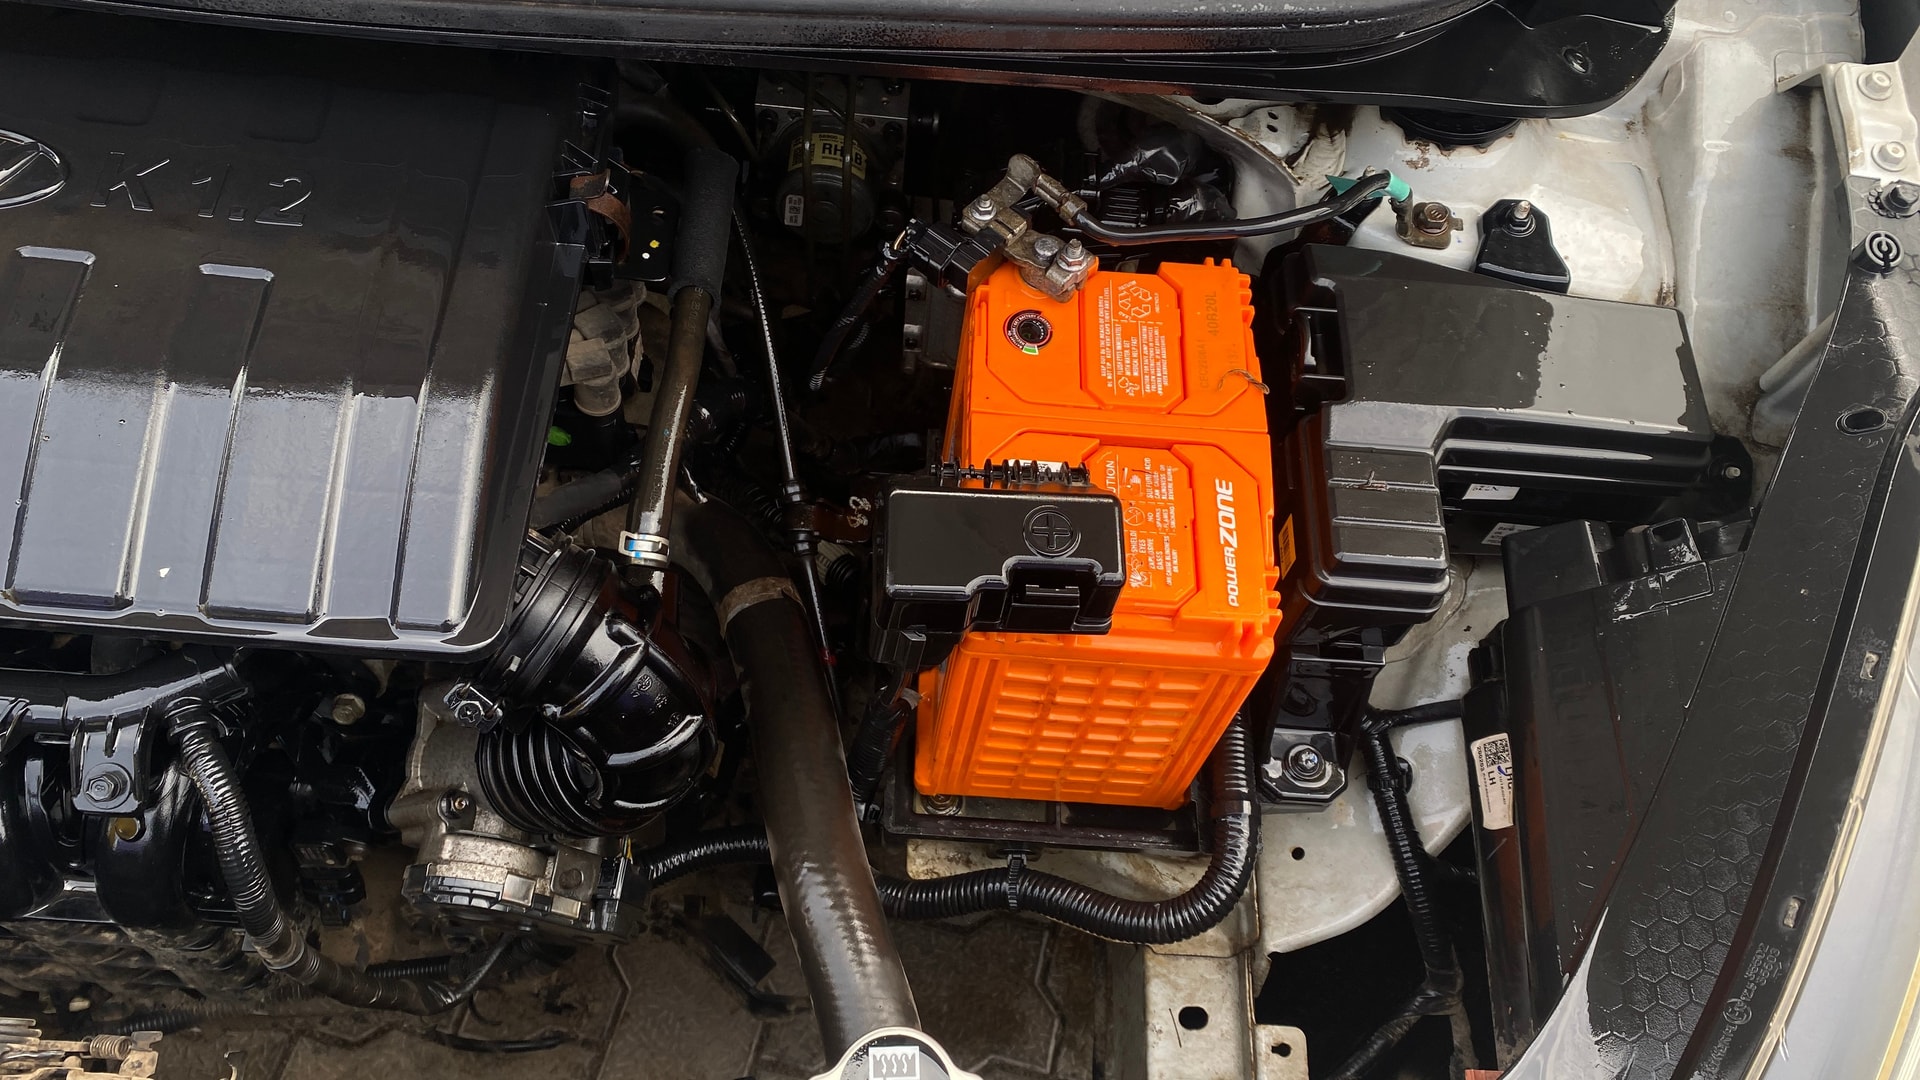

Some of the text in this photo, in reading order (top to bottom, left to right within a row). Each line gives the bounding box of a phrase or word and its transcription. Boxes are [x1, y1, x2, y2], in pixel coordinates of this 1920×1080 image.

[1205, 291, 1219, 336] 40B20L
[1106, 460, 1116, 493] UTION
[1147, 512, 1153, 522] NO
[1138, 539, 1146, 553] EYES
[1488, 771, 1496, 785] LH
